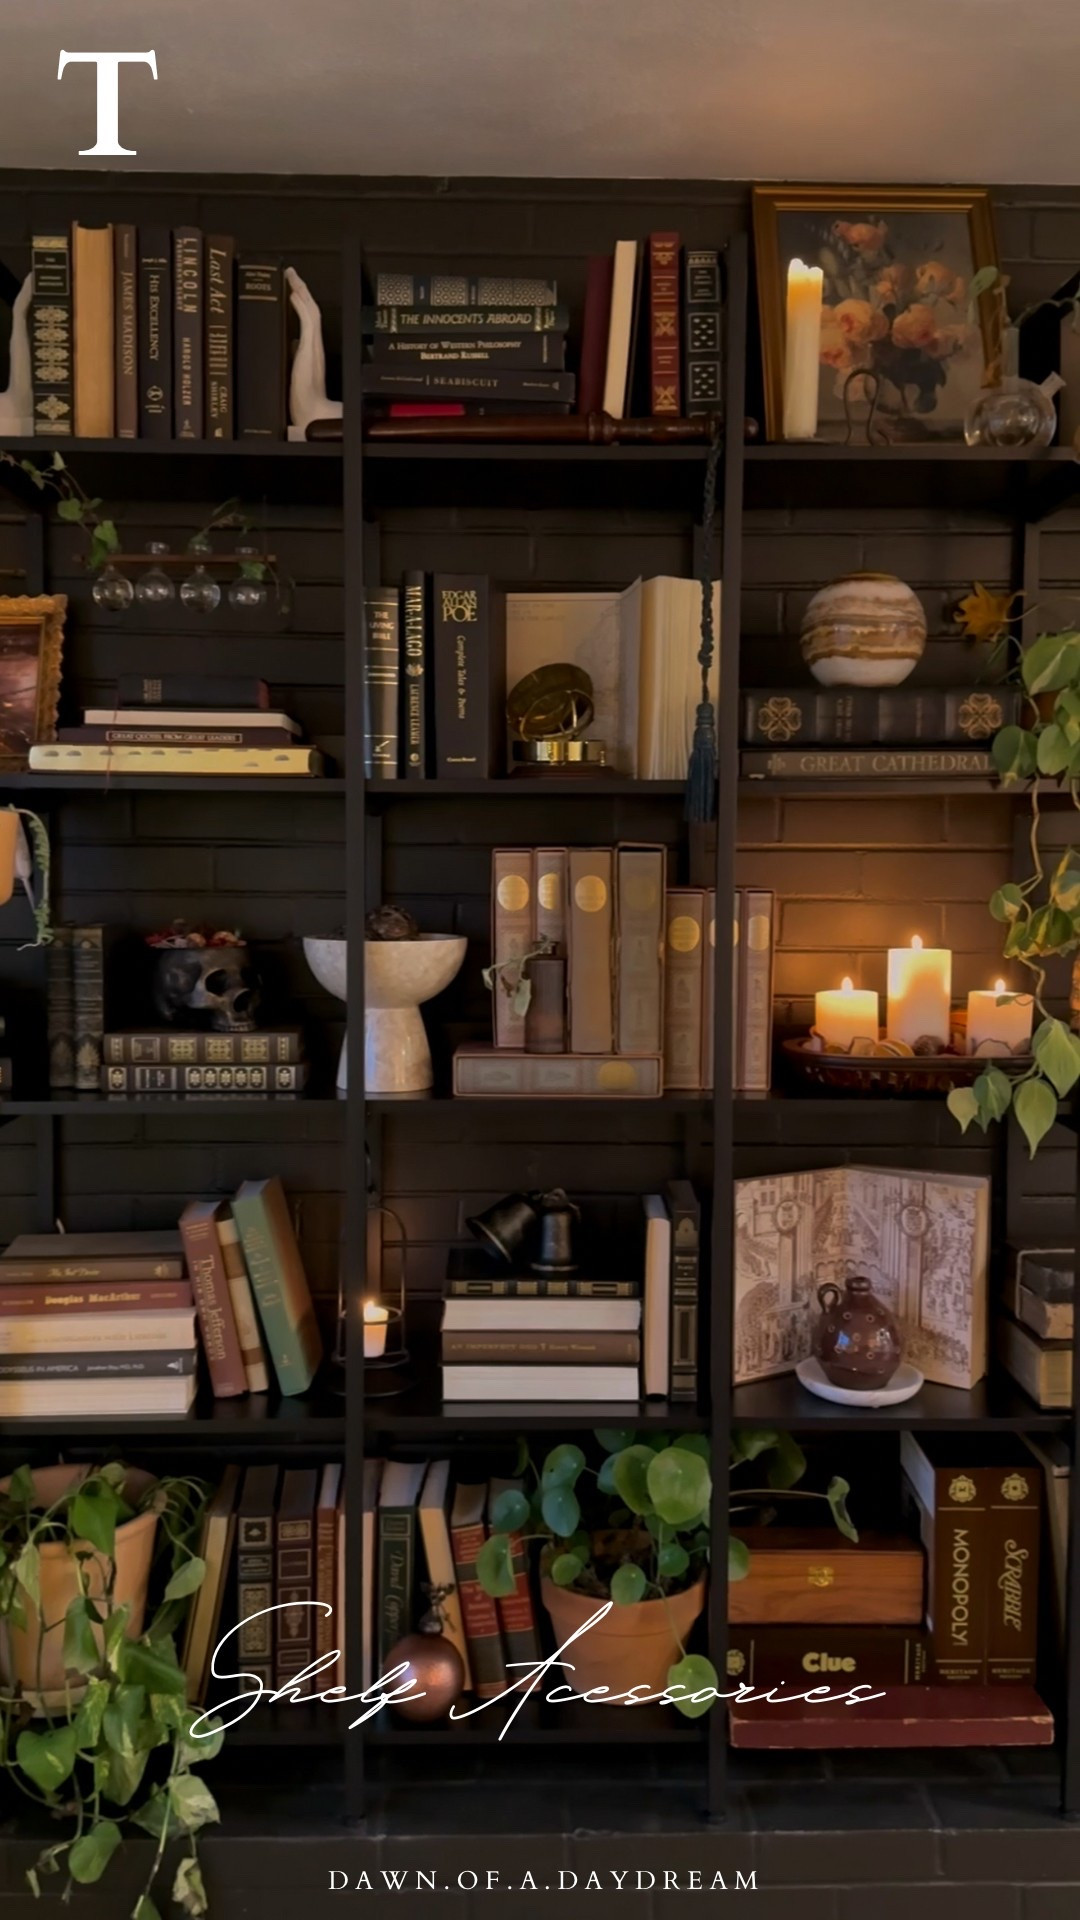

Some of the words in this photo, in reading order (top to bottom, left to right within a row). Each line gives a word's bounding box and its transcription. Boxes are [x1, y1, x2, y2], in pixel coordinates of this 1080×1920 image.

[182, 237, 198, 314] LINCOLN
[209, 248, 227, 284] Last
[120, 271, 134, 310] JAMES
[209, 287, 226, 314] Act
[400, 314, 420, 325] THE
[422, 313, 484, 325] INNOCENTS
[486, 313, 532, 324] ABROAD
[122, 314, 133, 375] MADISON
[182, 338, 192, 369] HAROLD
[433, 376, 499, 388] SEABISCUIT
[220, 386, 228, 412] CRAIG
[442, 590, 477, 599] EDGAR
[442, 598, 477, 608] ALLAN
[374, 611, 390, 620] THE
[442, 606, 478, 622] POE
[455, 635, 466, 667] Complete
[458, 669, 466, 685] Tales
[800, 756, 866, 772] GREAT
[200, 1254, 217, 1306] Thomas
[44, 1295, 84, 1306] Douglas
[88, 1292, 141, 1303] MacArthur
[207, 1307, 227, 1360] Jefferson
[950, 1528, 970, 1644] MONOPOLY
[802, 1652, 857, 1673] Clue
